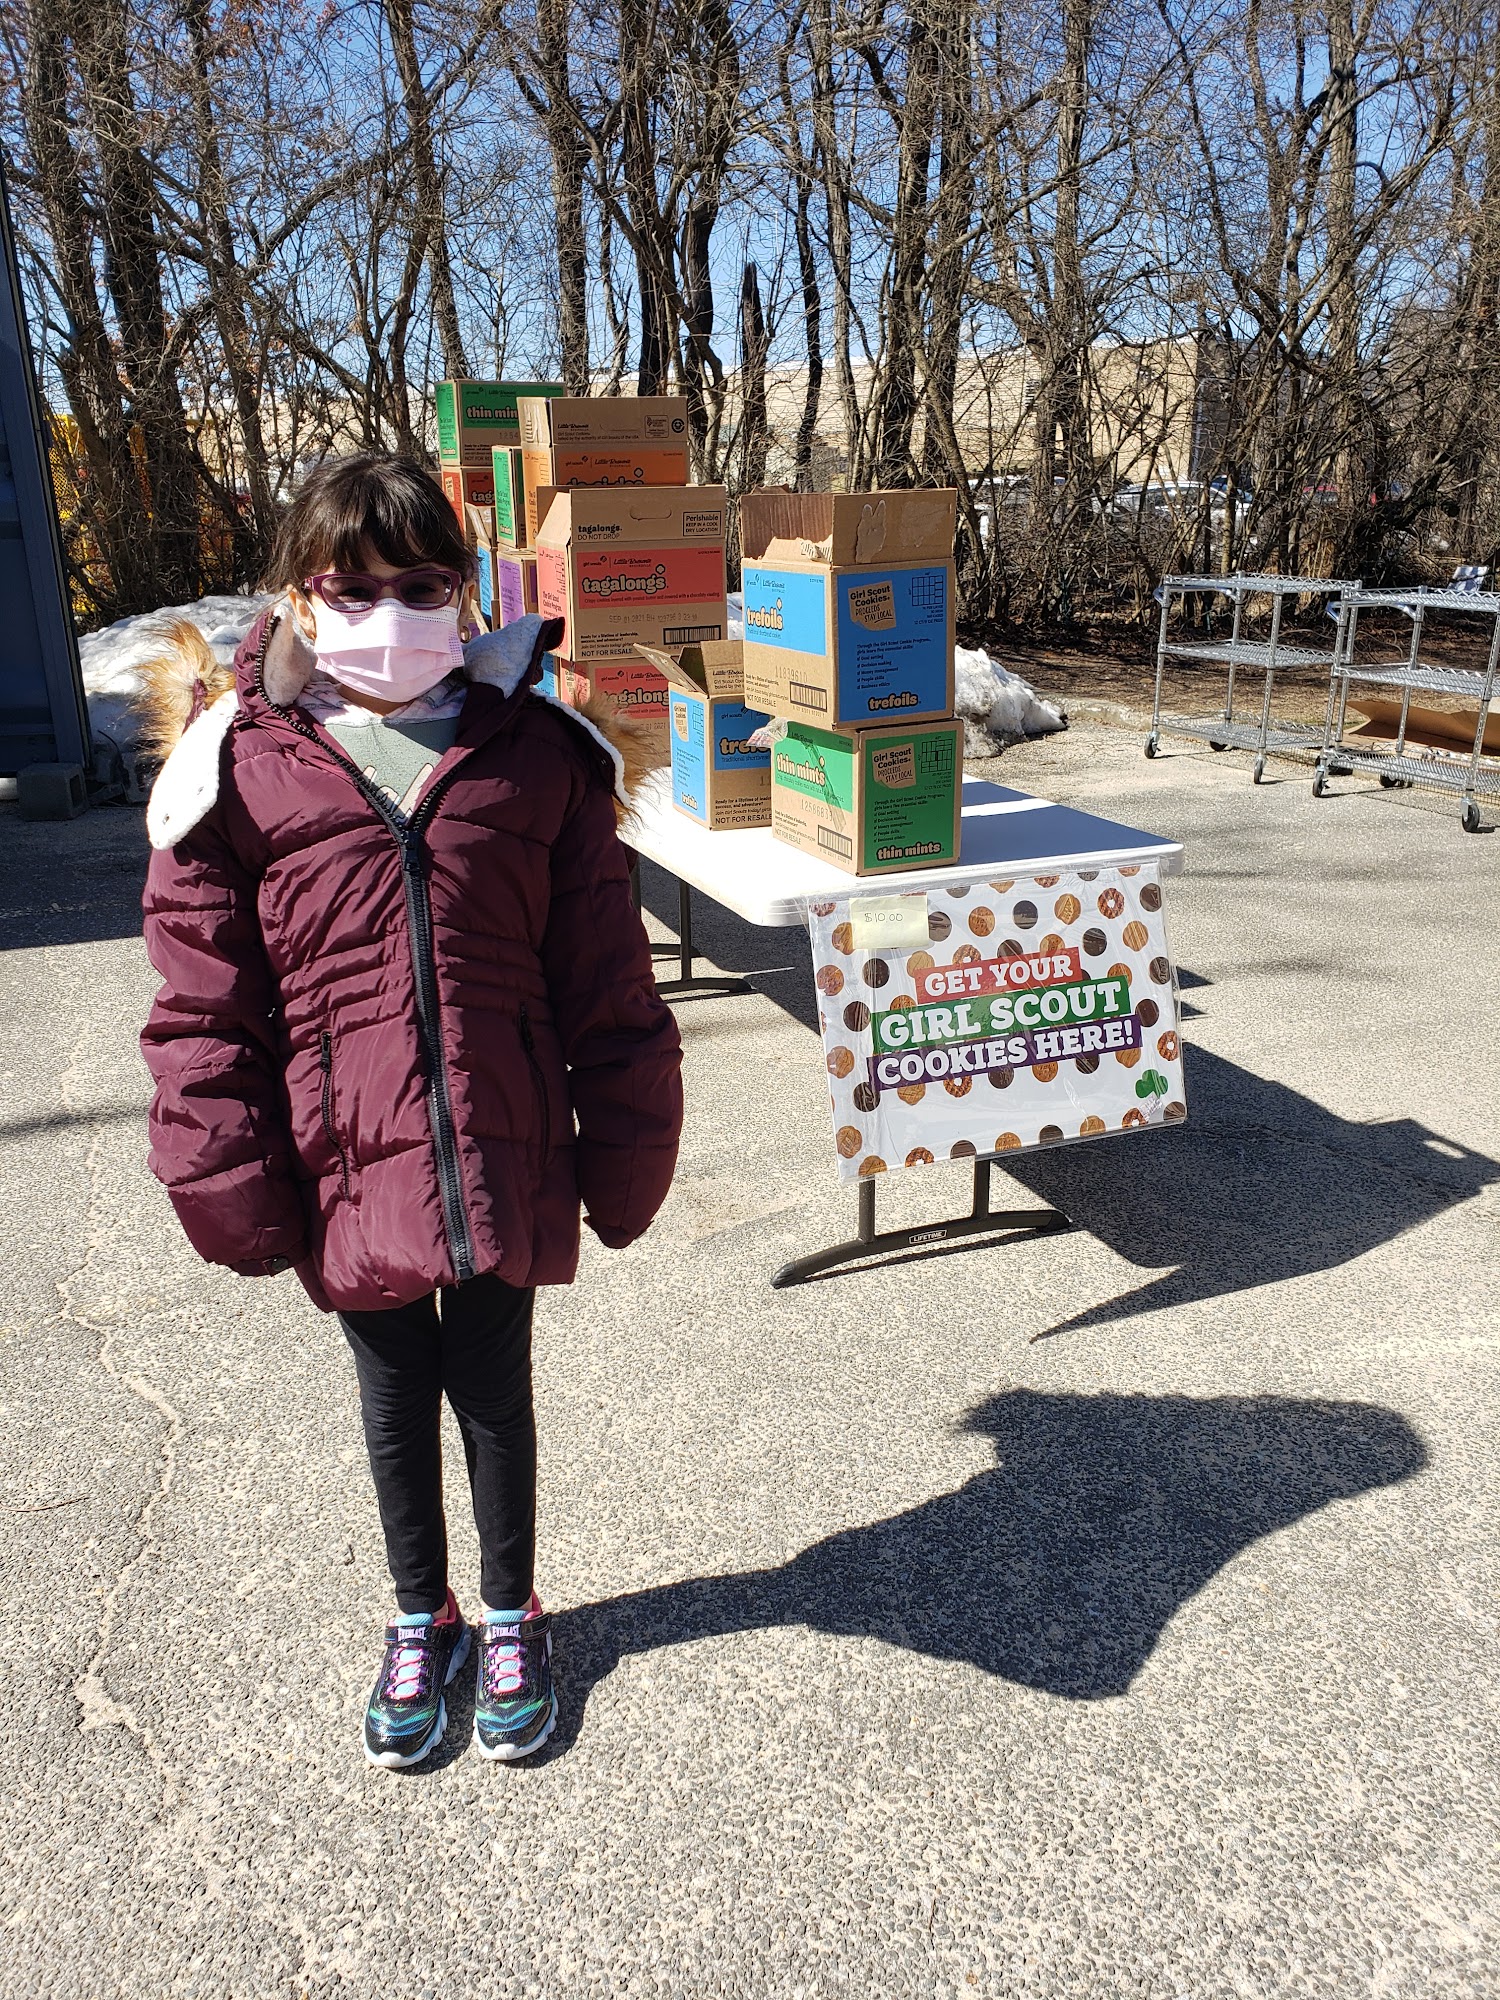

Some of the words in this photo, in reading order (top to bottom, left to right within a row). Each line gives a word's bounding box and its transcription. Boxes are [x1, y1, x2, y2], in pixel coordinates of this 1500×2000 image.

[466, 404, 493, 419] thin
[494, 404, 518, 419] min
[685, 514, 719, 522] Perishable
[577, 533, 587, 541] DO
[603, 532, 620, 540] DROP
[850, 589, 866, 601] Girl
[867, 585, 891, 597] Scout
[746, 605, 784, 631] trefoils
[864, 613, 877, 623] STAY
[877, 609, 893, 620] LOCAL
[868, 690, 919, 712] trefoils
[873, 752, 888, 763] Girl
[889, 747, 912, 759] Scout
[776, 752, 796, 777] thin
[796, 760, 826, 787] mints
[885, 773, 898, 783] STAY
[898, 769, 913, 779] LOCAL
[715, 817, 731, 825] NOT
[731, 815, 746, 823] FOR
[747, 813, 772, 822] RESALE
[876, 844, 904, 862] thin
[904, 841, 942, 858] mints
[864, 912, 904, 923] $10.00
[923, 966, 983, 997] GET
[988, 954, 1074, 988] YOUR
[879, 1003, 982, 1047] GIRL
[989, 980, 1122, 1031] SCOUT
[876, 1037, 1029, 1086] COOKIES
[1033, 1019, 1135, 1061] HERE!
[913, 1231, 943, 1242] LIFETIME
[398, 1627, 427, 1641] EVERLAST
[492, 1624, 521, 1639] EVERLAST
